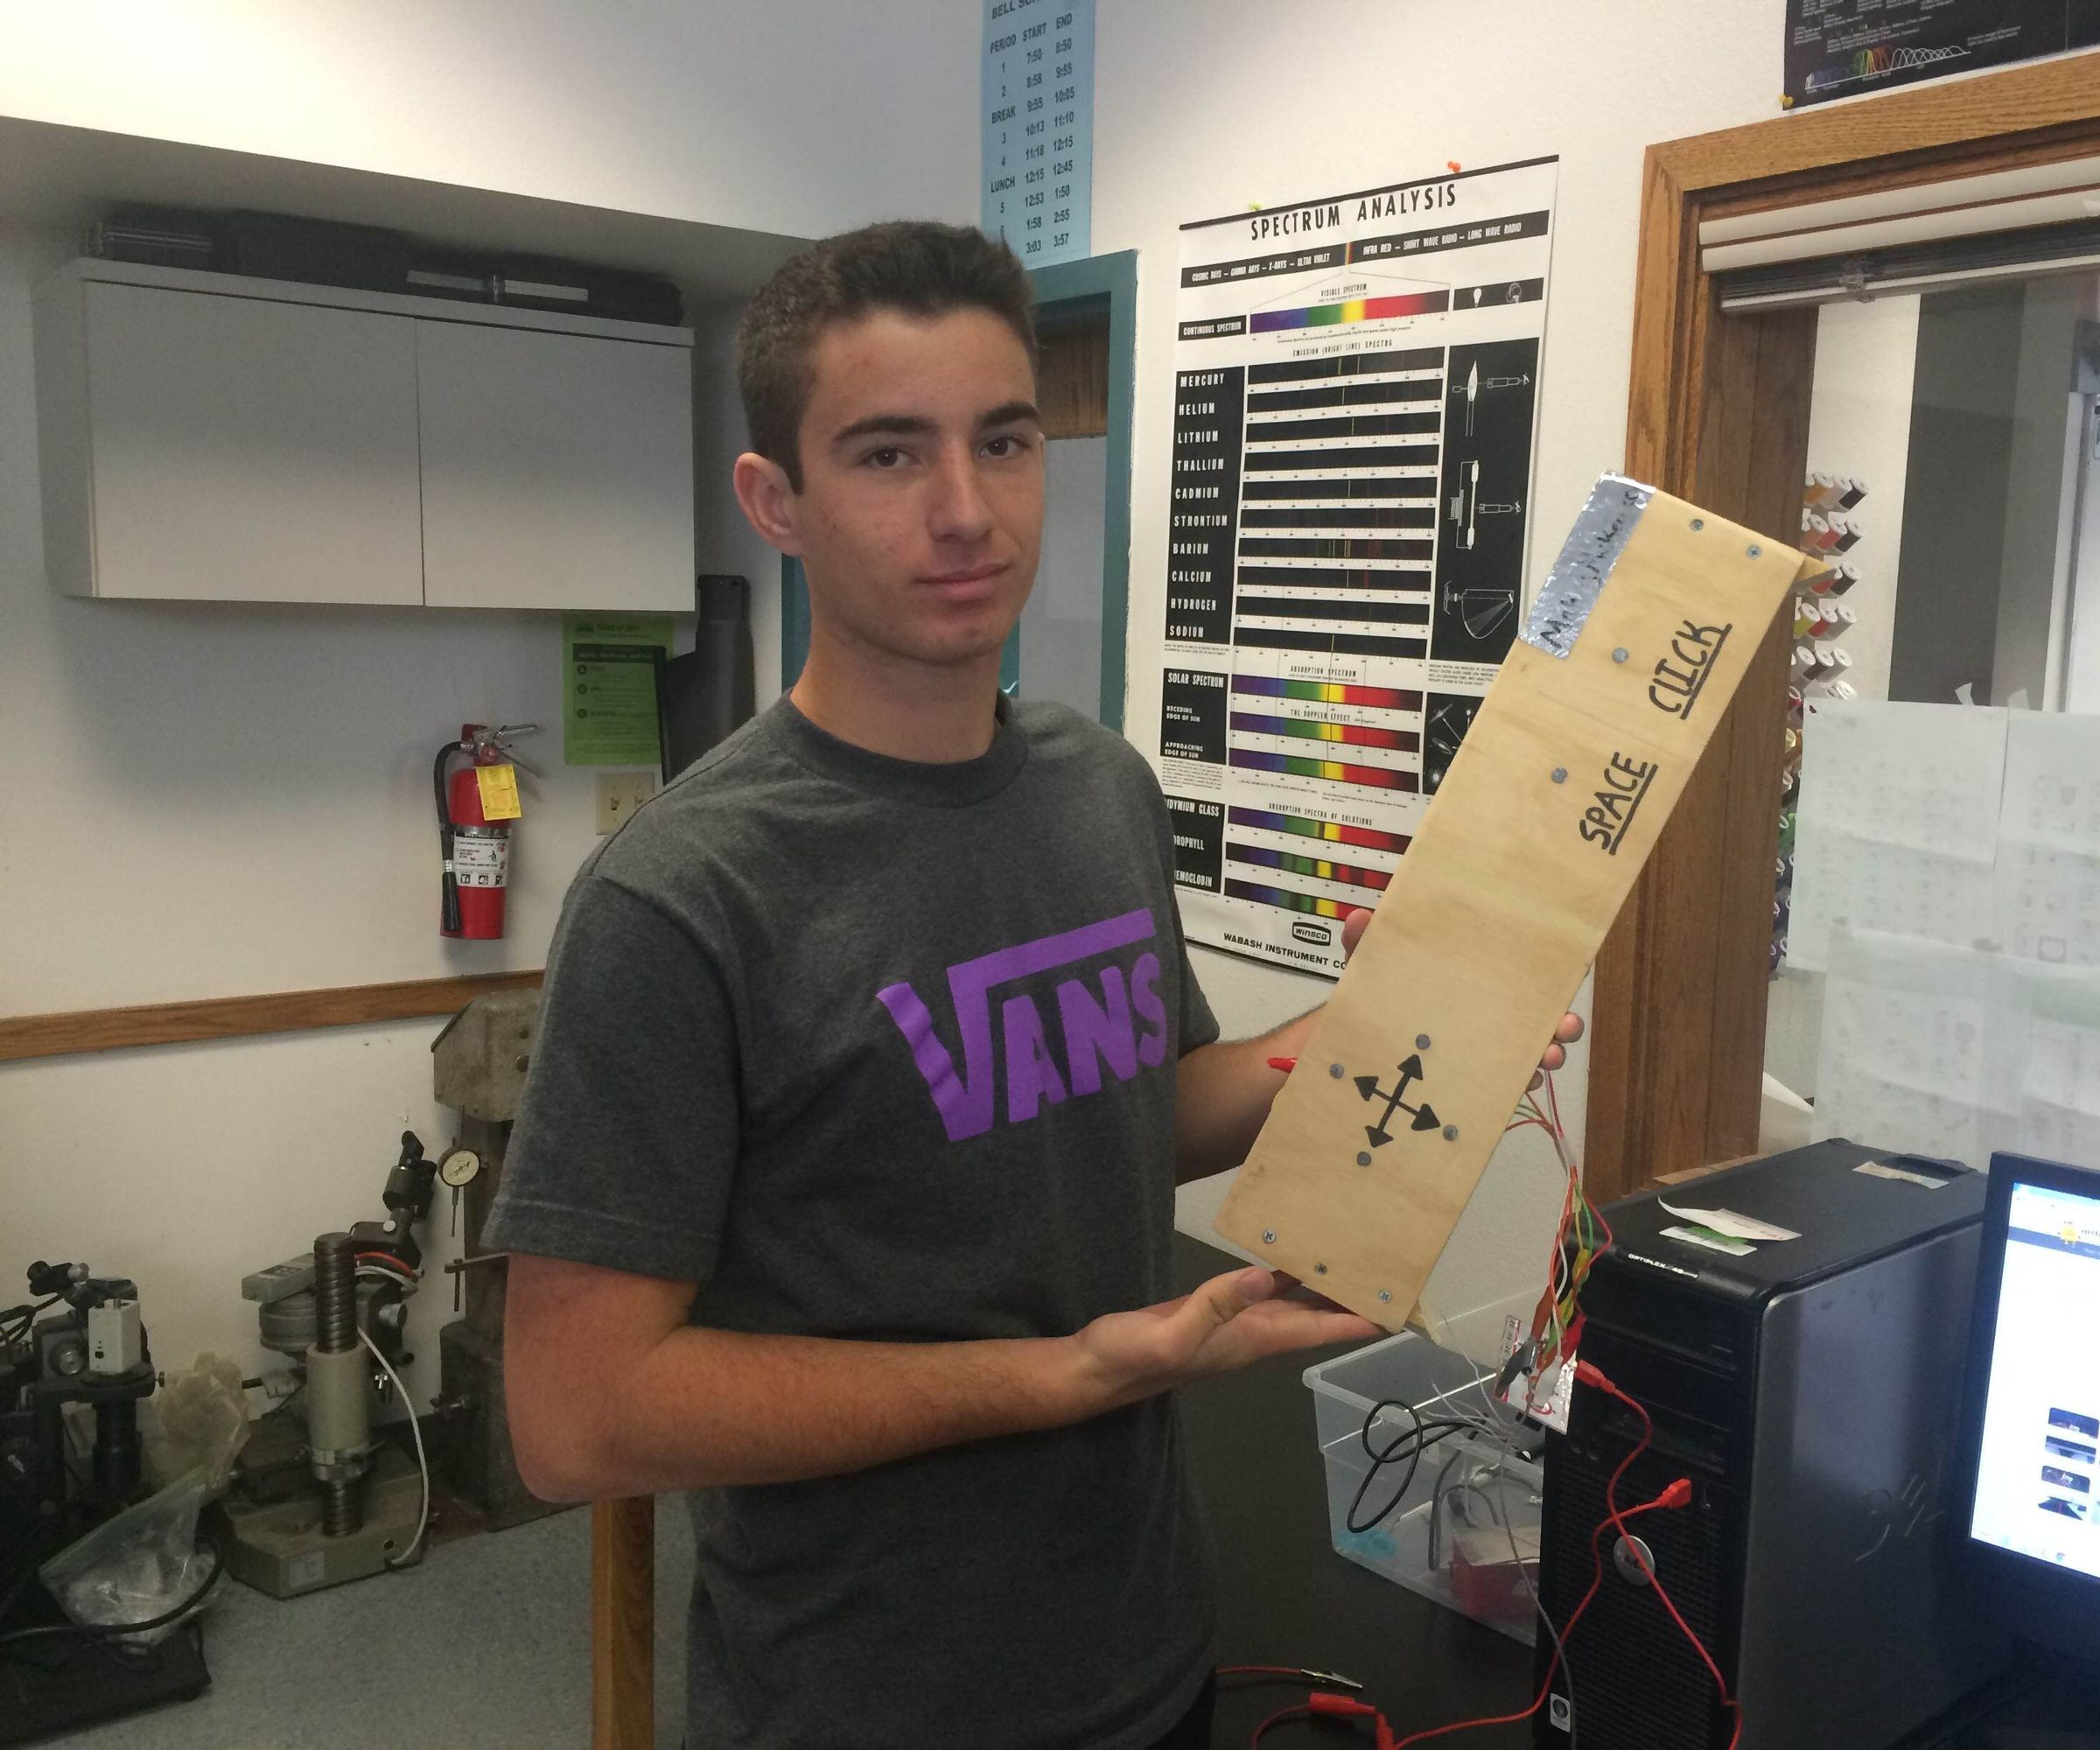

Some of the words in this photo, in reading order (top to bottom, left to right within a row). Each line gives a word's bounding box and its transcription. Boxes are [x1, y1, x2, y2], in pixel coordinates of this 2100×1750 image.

[992, 0, 1015, 19] BELL
[990, 33, 1017, 53] PERIOD
[1022, 22, 1047, 42] START
[1056, 12, 1072, 29] END
[1026, 48, 1043, 63] 7:50
[1055, 38, 1072, 53] 8:50
[1001, 85, 1006, 97] 2
[1026, 72, 1042, 88] 8:58
[1055, 62, 1073, 78] 9:55
[991, 106, 1016, 123] BREAK
[1027, 96, 1044, 112] 9:55
[1054, 86, 1074, 103] 10:05
[1002, 132, 1006, 144] 3
[1026, 120, 1045, 136] 10:13
[1054, 111, 1074, 127] 11:10
[1001, 155, 1006, 167] 4
[1026, 144, 1045, 160] 11:18
[1054, 135, 1074, 151] 12:15
[990, 176, 1015, 192] LUNCH
[1025, 168, 1045, 184] 12:15
[1053, 159, 1073, 175] 12:45
[1000, 202, 1004, 214] 5
[1025, 192, 1045, 207] 12:53
[1054, 185, 1070, 199] 1:50
[1026, 216, 1042, 230] 1:58
[1054, 208, 1070, 223] 2:55
[1251, 205, 1340, 241] SPECTRUM
[1357, 183, 1456, 221] ANALYSIS
[1026, 240, 1042, 254] 3:03
[1054, 233, 1069, 247] 3:57
[1269, 260, 1287, 270] X-RAYS
[1297, 256, 1312, 266] ULTRA
[1313, 253, 1331, 264] VIOLET
[1380, 242, 1392, 253] RED
[1403, 238, 1420, 250] SHORT
[1423, 235, 1438, 248] WAVE
[1442, 233, 1458, 244] RADIO
[1467, 228, 1482, 241] LONG
[1485, 225, 1501, 237] WAVE
[1503, 222, 1522, 234] RADIO
[1320, 287, 1340, 298] VISIBLE
[1343, 283, 1368, 293] SPECTRUM
[1183, 325, 1214, 336] CONTINUOUS
[1216, 321, 1242, 332] SPECTRUM
[1292, 347, 1319, 357] EMISSION
[1365, 339, 1393, 348] SPECTRA
[1180, 373, 1224, 388] MERCURY
[1179, 402, 1215, 416] HELIUM
[1178, 430, 1219, 444] LITHIUM
[1177, 458, 1224, 472] THALLIUM
[1175, 486, 1219, 500] CADMIUM
[1173, 514, 1228, 527] STRONTIUM
[1172, 542, 1209, 555] BARIUM
[1172, 570, 1212, 583] CALCIUM
[1171, 598, 1216, 611] HYDROGEN
[1169, 625, 1204, 638] SODIUM
[1290, 665, 1324, 675] ABSORPTION
[1326, 668, 1357, 677] SPECTRUM
[1648, 620, 1726, 715] CLICK
[1167, 672, 1190, 685] SOLAR
[1192, 675, 1224, 688] SPECTRUM
[1304, 710, 1327, 720] DOPPLER
[1330, 713, 1350, 722] EFFECT
[1165, 741, 1204, 752] APPROACHING
[1199, 803, 1220, 817] GLASS
[1579, 752, 1649, 850] SPACE
[1269, 802, 1301, 814] ABSORPTION
[1305, 808, 1327, 818] SPECTRA
[1341, 814, 1373, 826] SOLUTIONS
[1223, 932, 1263, 949] WABASH
[1265, 943, 1328, 965] INSTRUMENT
[875, 907, 1167, 1142] VANS
